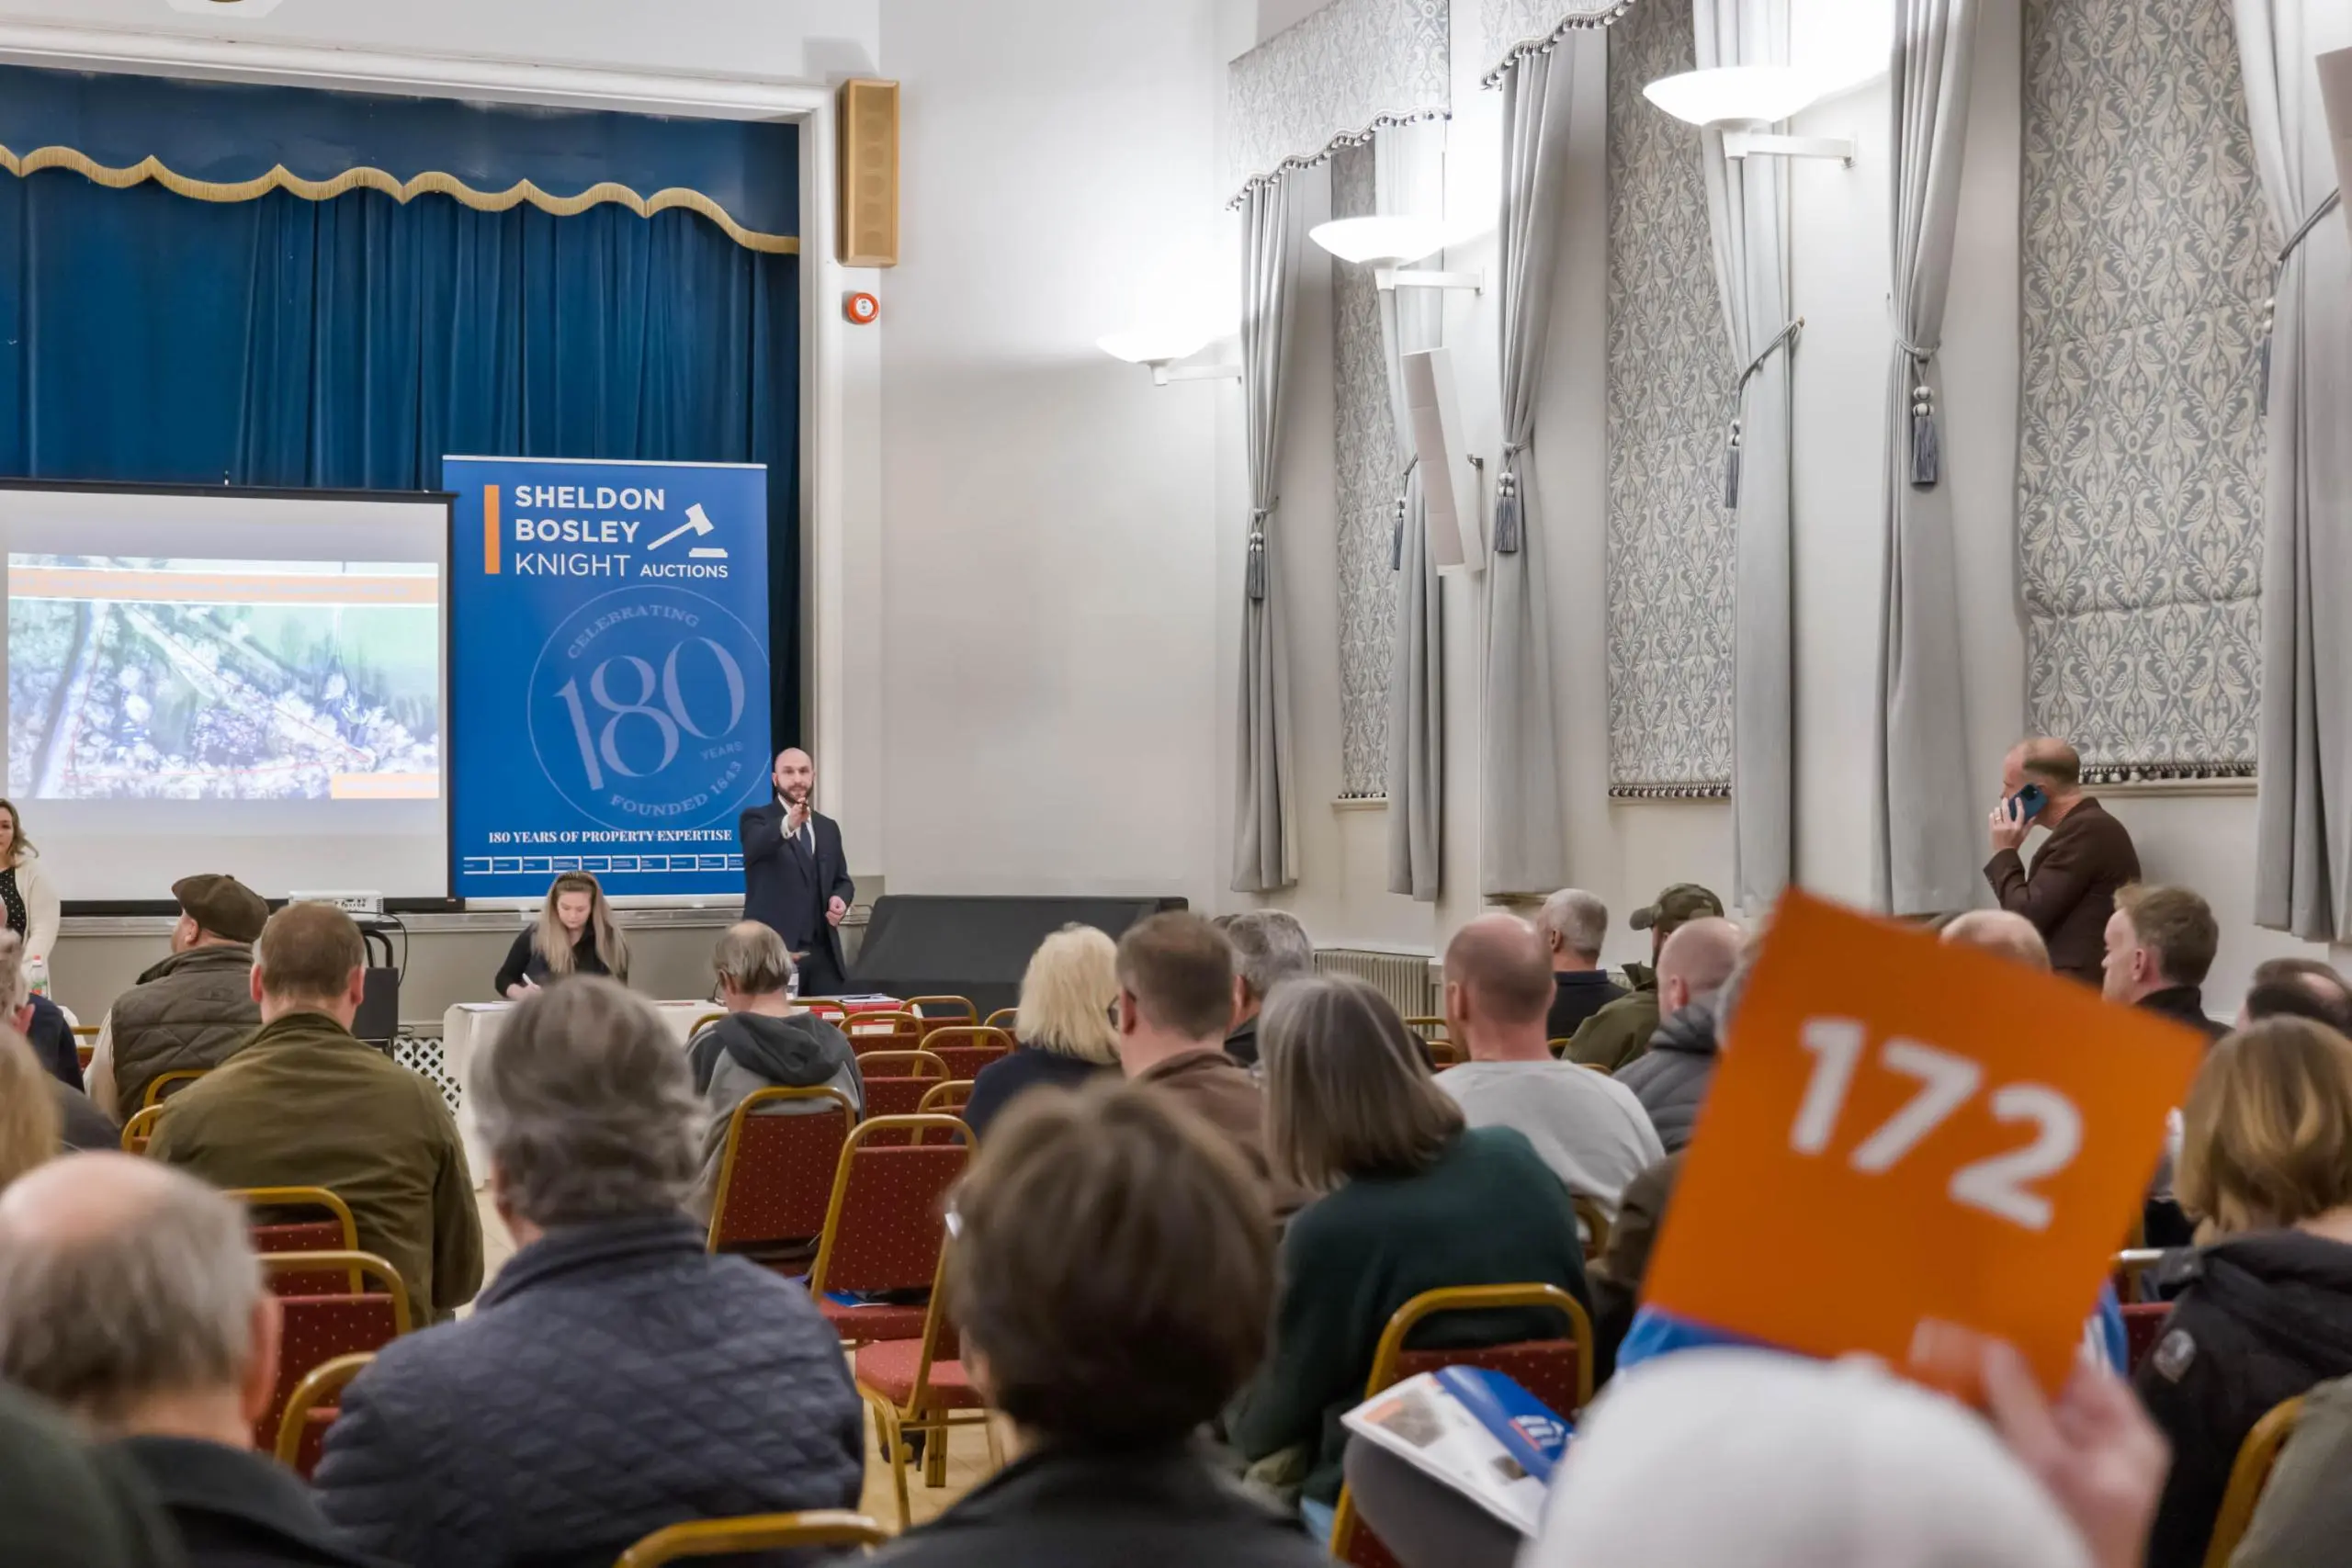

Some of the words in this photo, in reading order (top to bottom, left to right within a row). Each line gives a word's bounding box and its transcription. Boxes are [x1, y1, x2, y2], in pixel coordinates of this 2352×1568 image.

[514, 485, 664, 511] SHELDON
[514, 518, 640, 543] BOSLEY
[515, 552, 631, 577] KNIGHT
[639, 563, 729, 579] AUCTIONS
[568, 604, 699, 659] CELEBRATING
[552, 637, 744, 790] 180
[701, 741, 743, 761] YEARS
[610, 794, 707, 816] FOUNDED
[709, 761, 742, 795] 1843
[489, 831, 511, 843] 180
[513, 830, 557, 843] YEARS
[560, 830, 580, 842] OF
[582, 829, 655, 842] PROPERTY
[657, 829, 732, 841] EXPERTISE
[1790, 1018, 2083, 1231] 172
